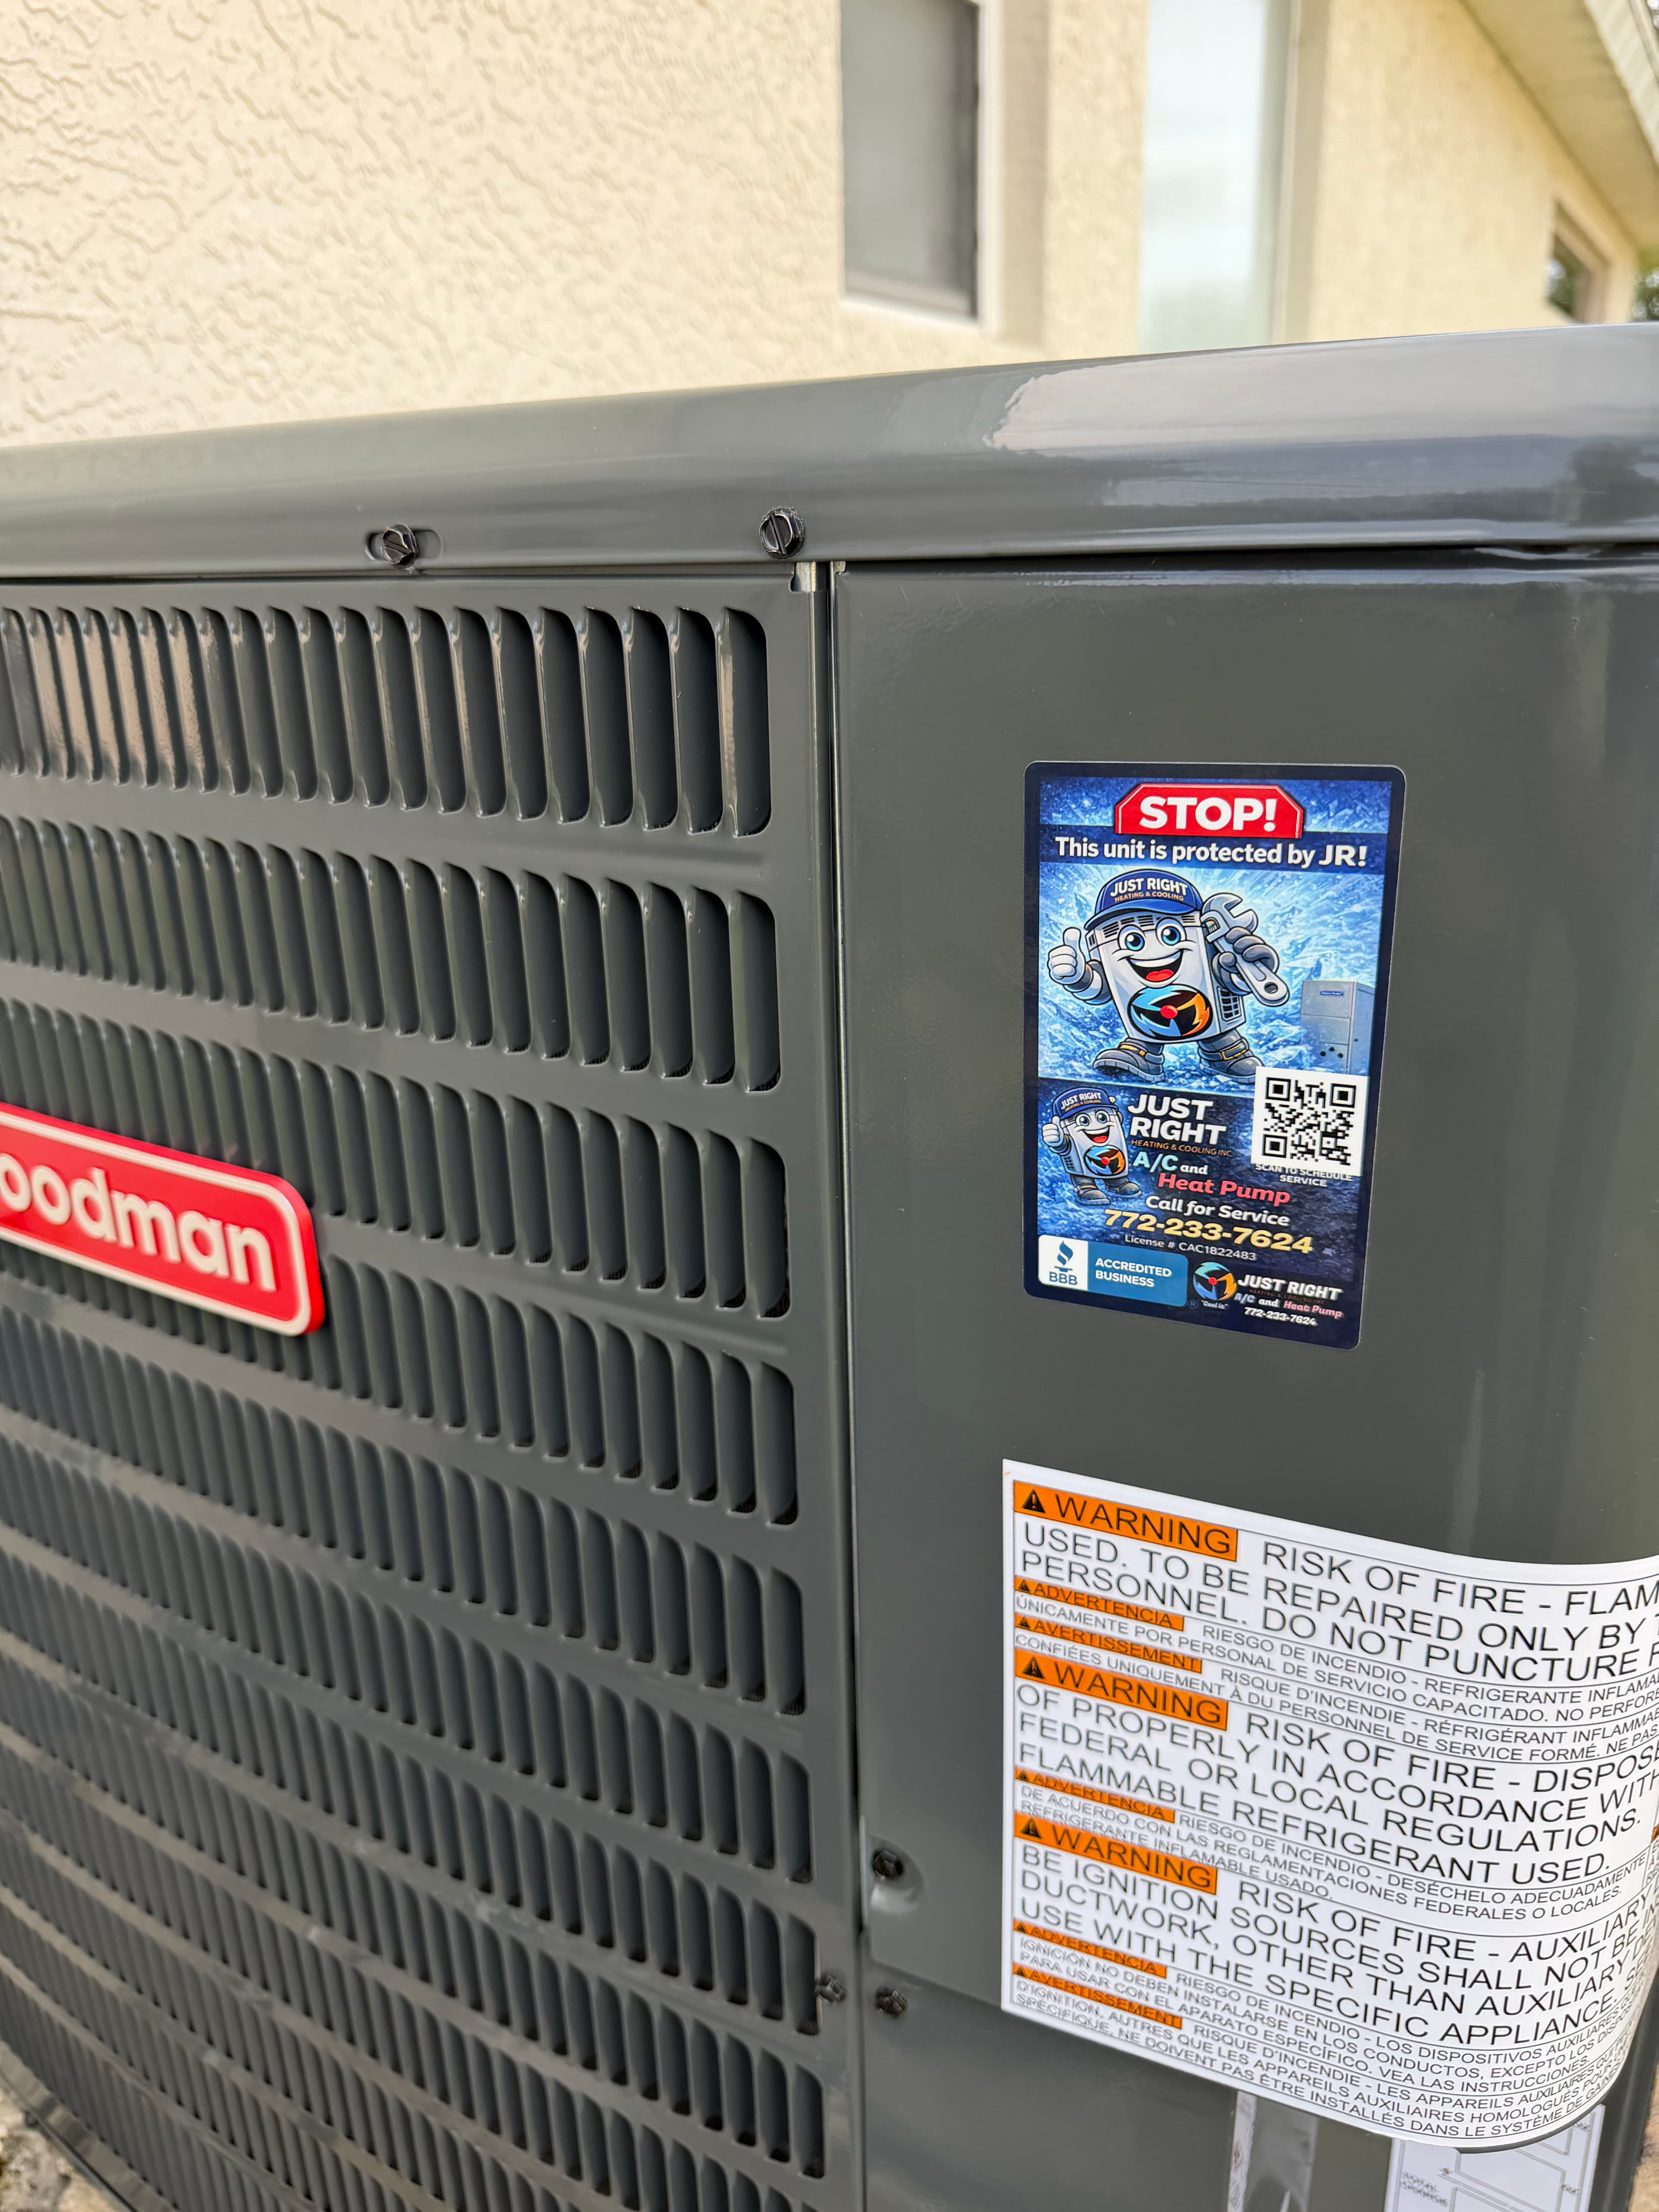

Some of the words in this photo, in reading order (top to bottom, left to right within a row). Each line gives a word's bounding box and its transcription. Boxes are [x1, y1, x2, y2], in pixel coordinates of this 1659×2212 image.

[1139, 797, 1276, 832] STOP!
[1055, 837, 1099, 857] This
[1104, 840, 1145, 860] unit
[1150, 841, 1165, 860] is
[1173, 842, 1282, 865] protected
[1287, 845, 1315, 868] by
[1319, 845, 1367, 867] JR!
[1110, 878, 1144, 896] JUST
[1147, 878, 1188, 896] RIGHT
[1115, 892, 1144, 903] HEATING
[1152, 891, 1184, 902] COOLING
[1061, 1095, 1077, 1109] JUST
[1079, 1092, 1101, 1101] RIGHT
[1128, 1094, 1214, 1120] JUST
[1130, 1117, 1227, 1145] RIGHT
[1131, 1139, 1169, 1150] HEATING
[1178, 1144, 1217, 1155] COOLING
[1133, 1151, 1179, 1173] A/C
[1180, 1164, 1208, 1175] and
[1158, 1173, 1214, 1194] Heat
[1220, 1180, 1290, 1207] Pump
[1279, 1175, 1328, 1187] SERVICE
[1104, 1209, 1313, 1254] 772-233-7624
[1146, 1195, 1184, 1212] Call
[1183, 1201, 1215, 1216] for
[1218, 1205, 1290, 1226] Service
[1095, 1258, 1172, 1277] ACCREDITED
[1125, 1234, 1164, 1248] License
[1168, 1241, 1175, 1249] #
[1178, 1242, 1257, 1261] CAC1822483
[1049, 1271, 1077, 1285] BBB
[1095, 1270, 1155, 1287] BUSINESS
[1234, 1292, 1256, 1304] A/C
[1258, 1299, 1280, 1308] and
[1283, 1300, 1309, 1312] Heat
[1312, 1305, 1343, 1319] Pump
[1237, 1274, 1286, 1292] JUST
[1287, 1281, 1343, 1301] RIGHT
[1244, 1306, 1318, 1326] 772-233-7624
[1055, 1494, 1230, 1554] WARNING
[1263, 1541, 1352, 1584] RISK
[1365, 1566, 1420, 1594] OF
[1433, 1578, 1525, 1614] FIRE
[1024, 1522, 1126, 1567] USED.
[1141, 1548, 1189, 1580] TO
[1202, 1563, 1249, 1595] BE
[1263, 1576, 1463, 1641] REPAIRED
[1478, 1623, 1589, 1651] ONLY
[1599, 1618, 1646, 1649] BY
[1023, 1550, 1247, 1624] PERSONNEL.
[1262, 1606, 1316, 1638] DO
[1331, 1622, 1412, 1661] NOT
[1425, 1643, 1640, 1681] PUNCTURE
[1033, 1582, 1173, 1627] ADVERTENCIA
[1203, 1625, 1274, 1653] RIESGO
[1281, 1644, 1305, 1660] DE
[1313, 1652, 1406, 1684] INCENDIO
[1425, 1678, 1582, 1704] REFRIGERANTE
[1017, 1596, 1128, 1635] ÚNICAMENTE
[1135, 1625, 1173, 1645] POR
[1178, 1636, 1276, 1671] PERSONAL
[1283, 1662, 1307, 1678] DE
[1314, 1670, 1406, 1701] SERVICIO
[1413, 1694, 1548, 1722] CAPACITADO.
[1556, 1709, 1583, 1721] NO
[1034, 1618, 1197, 1670] AVERTISSEMENT
[1221, 1669, 1290, 1695] RISQUE
[1297, 1688, 1405, 1725] D'INCENDIE
[1425, 1718, 1567, 1744] RÉFRIGÉRANT
[1016, 1633, 1101, 1665] CONFIÉES
[1107, 1658, 1225, 1697] UNIQUEMENT
[1248, 1692, 1273, 1708] DU
[1280, 1700, 1395, 1739] PERSONNEL
[1402, 1731, 1428, 1747] DE
[1436, 1738, 1523, 1761] SERVICE
[1529, 1743, 1600, 1761] FORMÉ.
[1606, 1738, 1628, 1754] NE
[1632, 1723, 1658, 1746] PAS
[1054, 1661, 1221, 1724] WARNING
[1246, 1712, 1331, 1755] RISK
[1343, 1739, 1395, 1767] OF
[1408, 1754, 1496, 1790] FIRE
[1017, 1684, 1061, 1710] OF
[1073, 1697, 1260, 1763] PROPERLY
[1272, 1749, 1305, 1778] IN
[1316, 1763, 1588, 1823] ACCORDANCE
[1020, 1712, 1171, 1771] FEDERAL
[1188, 1759, 1239, 1789] OR
[1251, 1773, 1369, 1825] LOCAL
[1383, 1808, 1640, 1852] REGULATIONS.
[1020, 1743, 1219, 1815] FLAMMABLE
[1232, 1800, 1500, 1883] REFRIGERANT
[1513, 1853, 1610, 1885] USED.
[1179, 1815, 1246, 1842] RIESGO
[1252, 1836, 1275, 1851] DE
[1282, 1843, 1370, 1878] INCENDIO
[1388, 1874, 1506, 1904] DESÉCHELO
[1511, 1853, 1646, 1904] ADECUADAMENTE
[1215, 1840, 1408, 1906] REGLAMENTACIONES
[1414, 1897, 1526, 1920] FEDERALES
[1551, 1885, 1622, 1917] LOCALES.
[1266, 1870, 1333, 1900] USADO.
[1023, 1845, 1062, 1874] BE
[1074, 1859, 1217, 1920] IGNITION
[1230, 1907, 1403, 1975] SOURCES
[1418, 1962, 1532, 1989] SHALL
[1545, 1946, 1606, 1986] NOT
[1612, 1920, 1640, 1958] BE
[1051, 1824, 1211, 1888] WARNING
[1239, 1880, 1319, 1923] RISK
[1332, 1910, 1380, 1936] OF
[1393, 1926, 1476, 1961] FIRE
[1509, 1884, 1652, 1962] AUXILIARY
[1021, 1870, 1218, 1949] DUCTWORK,
[1233, 1934, 1354, 1989] OTHER
[1367, 1973, 1465, 2014] THAN
[1475, 1949, 1630, 2016] AUXILIARY
[1021, 1897, 1083, 1933] USE
[1094, 1920, 1175, 1963] WITH
[1189, 1948, 1254, 1987] THE
[1265, 1974, 1428, 2037] SPECIFIC
[1439, 1988, 1617, 2045] APPLIANCE.
[1246, 1996, 1269, 2011] DE
[1275, 2003, 1360, 2039] INCENDIO
[1377, 2037, 1411, 2054] LOS
[1419, 2047, 1541, 2064] DISPOSITIVOS
[1295, 2025, 1317, 2041] EN
[1323, 2033, 1358, 2053] LOS
[1364, 2048, 1484, 2080] CONDUCTOS,
[1491, 2054, 1566, 2079] EXCEPTO
[1569, 2038, 1595, 2060] LOS
[1263, 2050, 1360, 2087] D'INCENDIE
[1377, 2083, 1411, 2100] LES
[1416, 2094, 1513, 2109] APPAREILS
[1518, 2065, 1594, 2104] AUXILIAIRES
[1264, 2031, 1372, 2074] ESPECÍFICO.
[1379, 2067, 1414, 2084] VEA
[1421, 2077, 1454, 2090] LAS
[1461, 2055, 1590, 2092] INSTRUCCIONES.
[1255, 2059, 1349, 2098] APPAREILS
[1355, 2092, 1464, 2122] AUXILIAIRES
[1471, 2087, 1579, 2123] HOMOLOGUÉS
[1260, 2075, 1304, 2096] ÊTRE
[1311, 2090, 1405, 2127] INSTALLÉS
[1411, 2119, 1459, 2136] DANS
[1465, 2125, 1485, 2137] LE
[1491, 2110, 1564, 2136] SYSTÈME
[1566, 2098, 1582, 2113] DE
